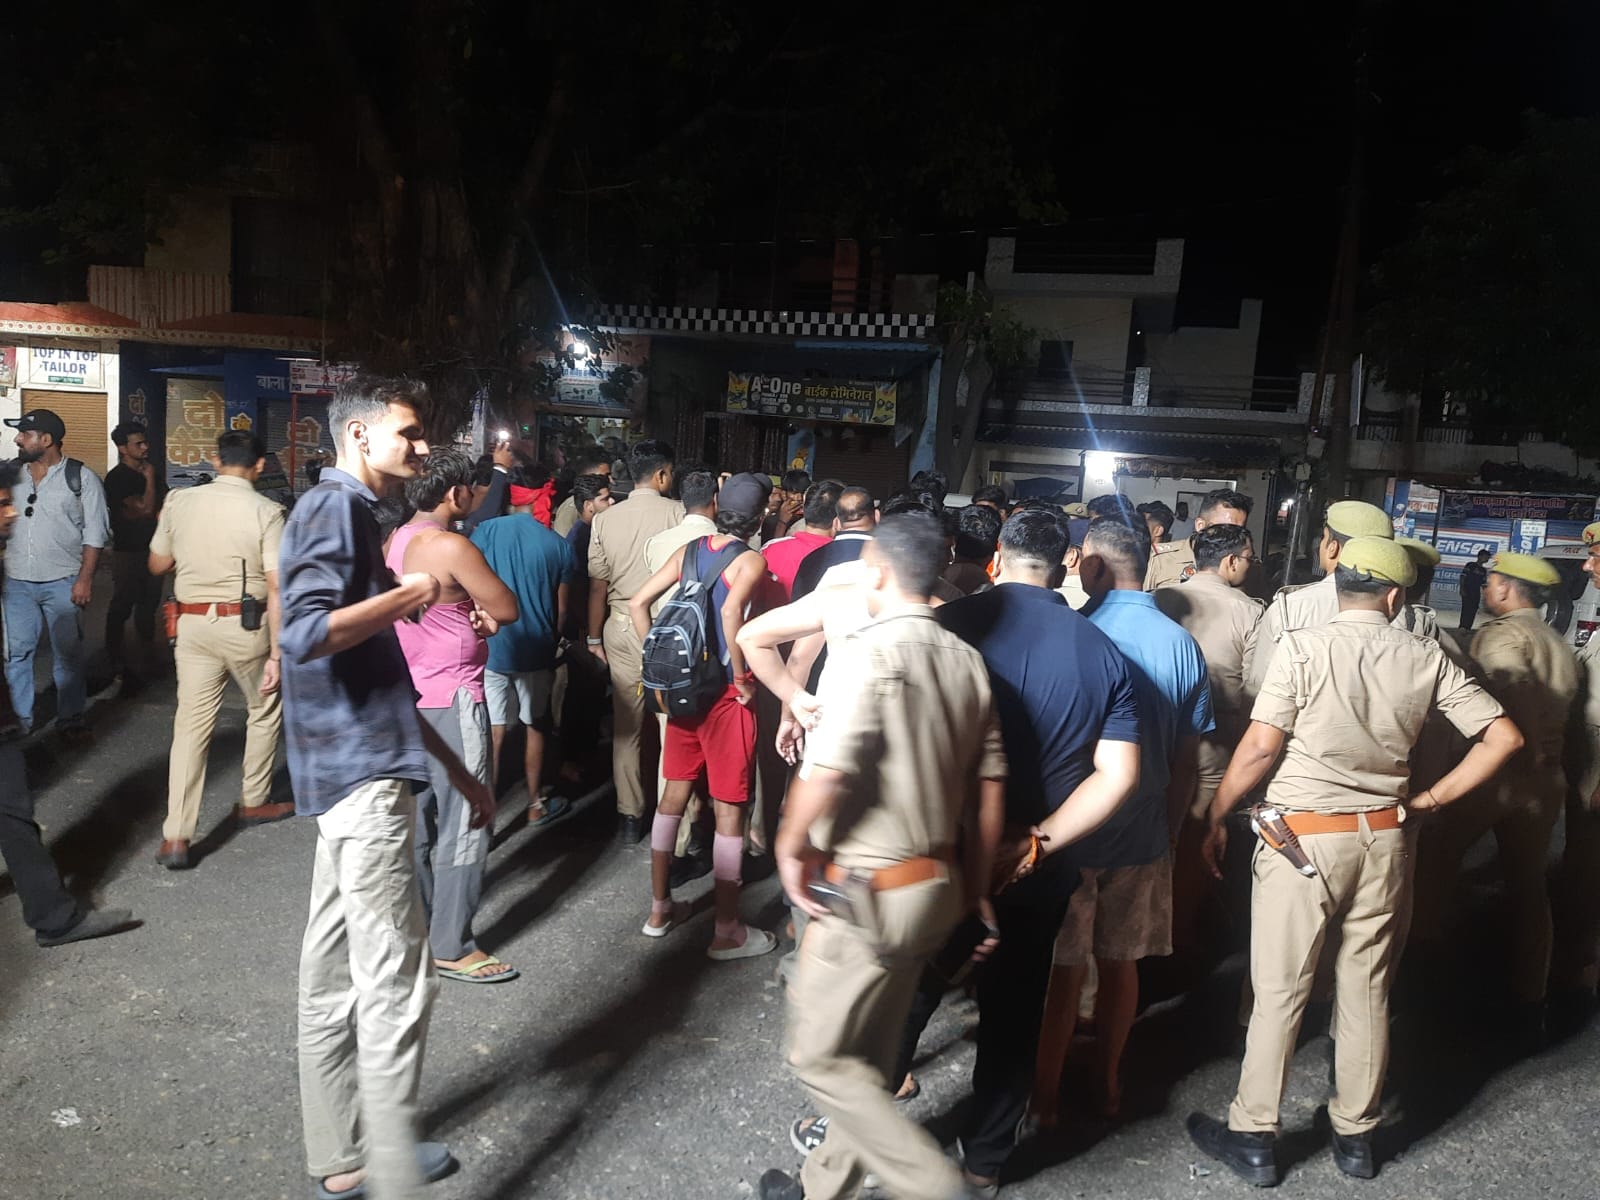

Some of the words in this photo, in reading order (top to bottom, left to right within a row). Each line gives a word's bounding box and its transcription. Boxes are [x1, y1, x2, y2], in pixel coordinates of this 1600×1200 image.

[32, 347, 55, 359] TOP
[58, 348, 71, 360] IN
[75, 350, 98, 361] TOP
[42, 361, 87, 374] TAILOR
[751, 376, 802, 395] A-One
